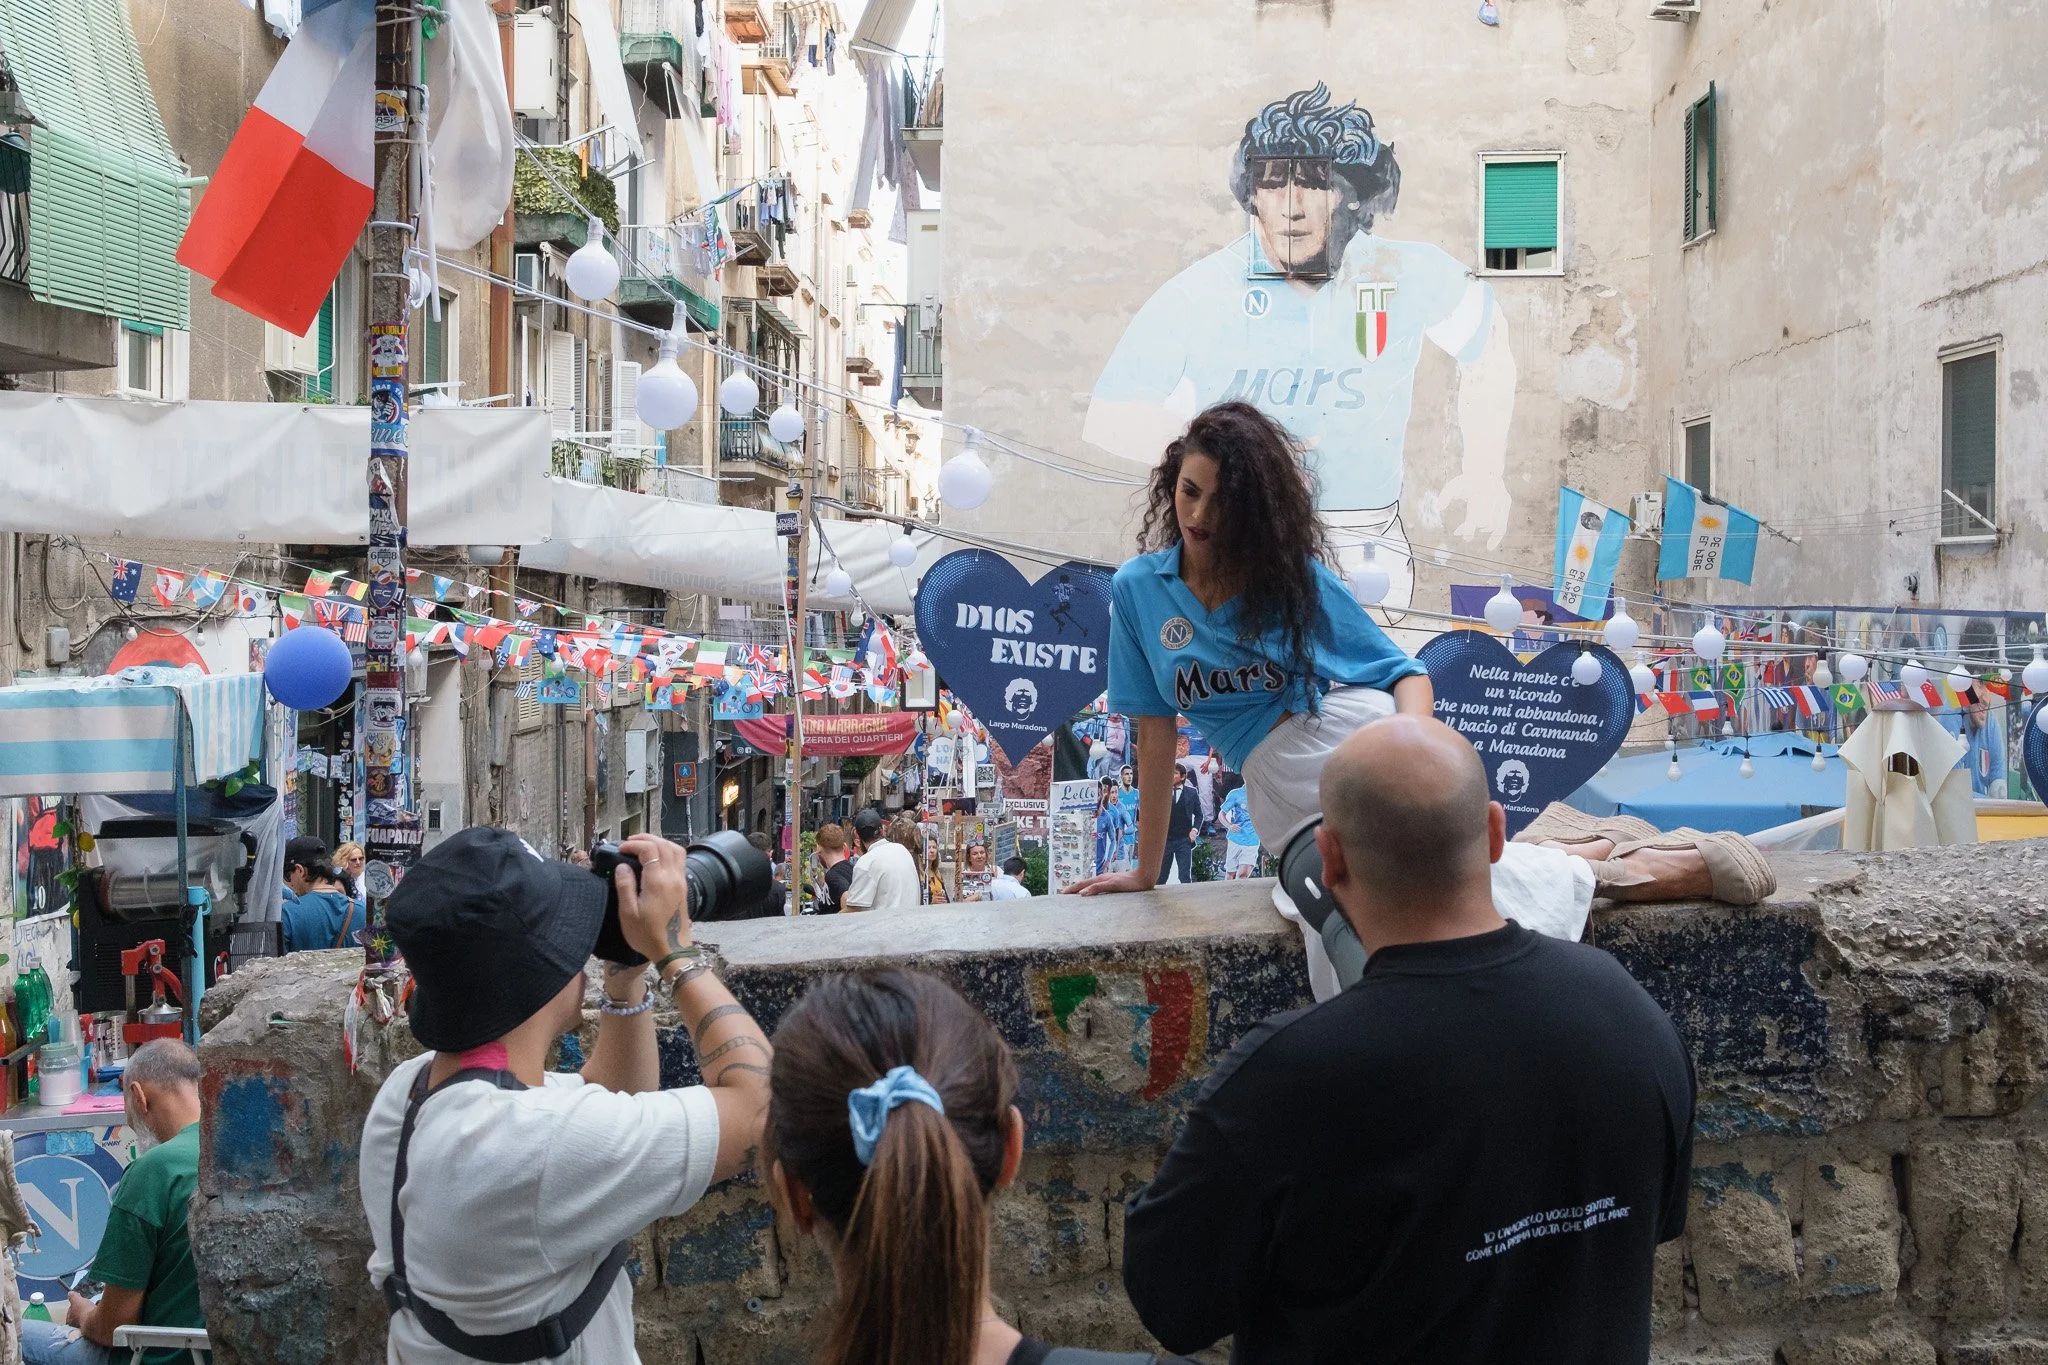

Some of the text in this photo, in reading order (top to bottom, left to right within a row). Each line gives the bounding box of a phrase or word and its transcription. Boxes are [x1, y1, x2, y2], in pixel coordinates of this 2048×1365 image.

[1246, 293, 1266, 313] N
[373, 589, 392, 597] FC
[955, 602, 1035, 635] DIOS
[1169, 626, 1184, 642] N
[989, 637, 1099, 675] EXISTE
[1174, 660, 1287, 710] Mars
[1469, 664, 1510, 681] Nella
[1512, 671, 1558, 686] mente
[1484, 687, 1562, 704] un ricordo
[1433, 698, 1457, 712] che
[1460, 702, 1489, 715] non
[1492, 704, 1512, 718] mi
[989, 719, 1048, 732] Largo Maradona
[1458, 718, 1498, 735] bacio
[1500, 721, 1517, 736] di
[1521, 722, 1599, 743] Carmando
[835, 736, 851, 744] DEI
[852, 734, 903, 744] QUARTIERI
[1473, 738, 1567, 760] a Maradona
[1061, 784, 1096, 801] Lello
[1005, 801, 1045, 809] EXCLUSIVE
[1503, 803, 1540, 814] Maradona
[18, 1176, 85, 1254] N
[1545, 1206, 1584, 1221] VOGLIO
[1465, 1245, 1493, 1263] COME
[1494, 1242, 1507, 1254] LA
[1531, 1223, 1560, 1238] VOLTA
[1561, 1221, 1582, 1233] CHE
[1598, 1211, 1607, 1223] IL
[1608, 1206, 1631, 1221] MARE
